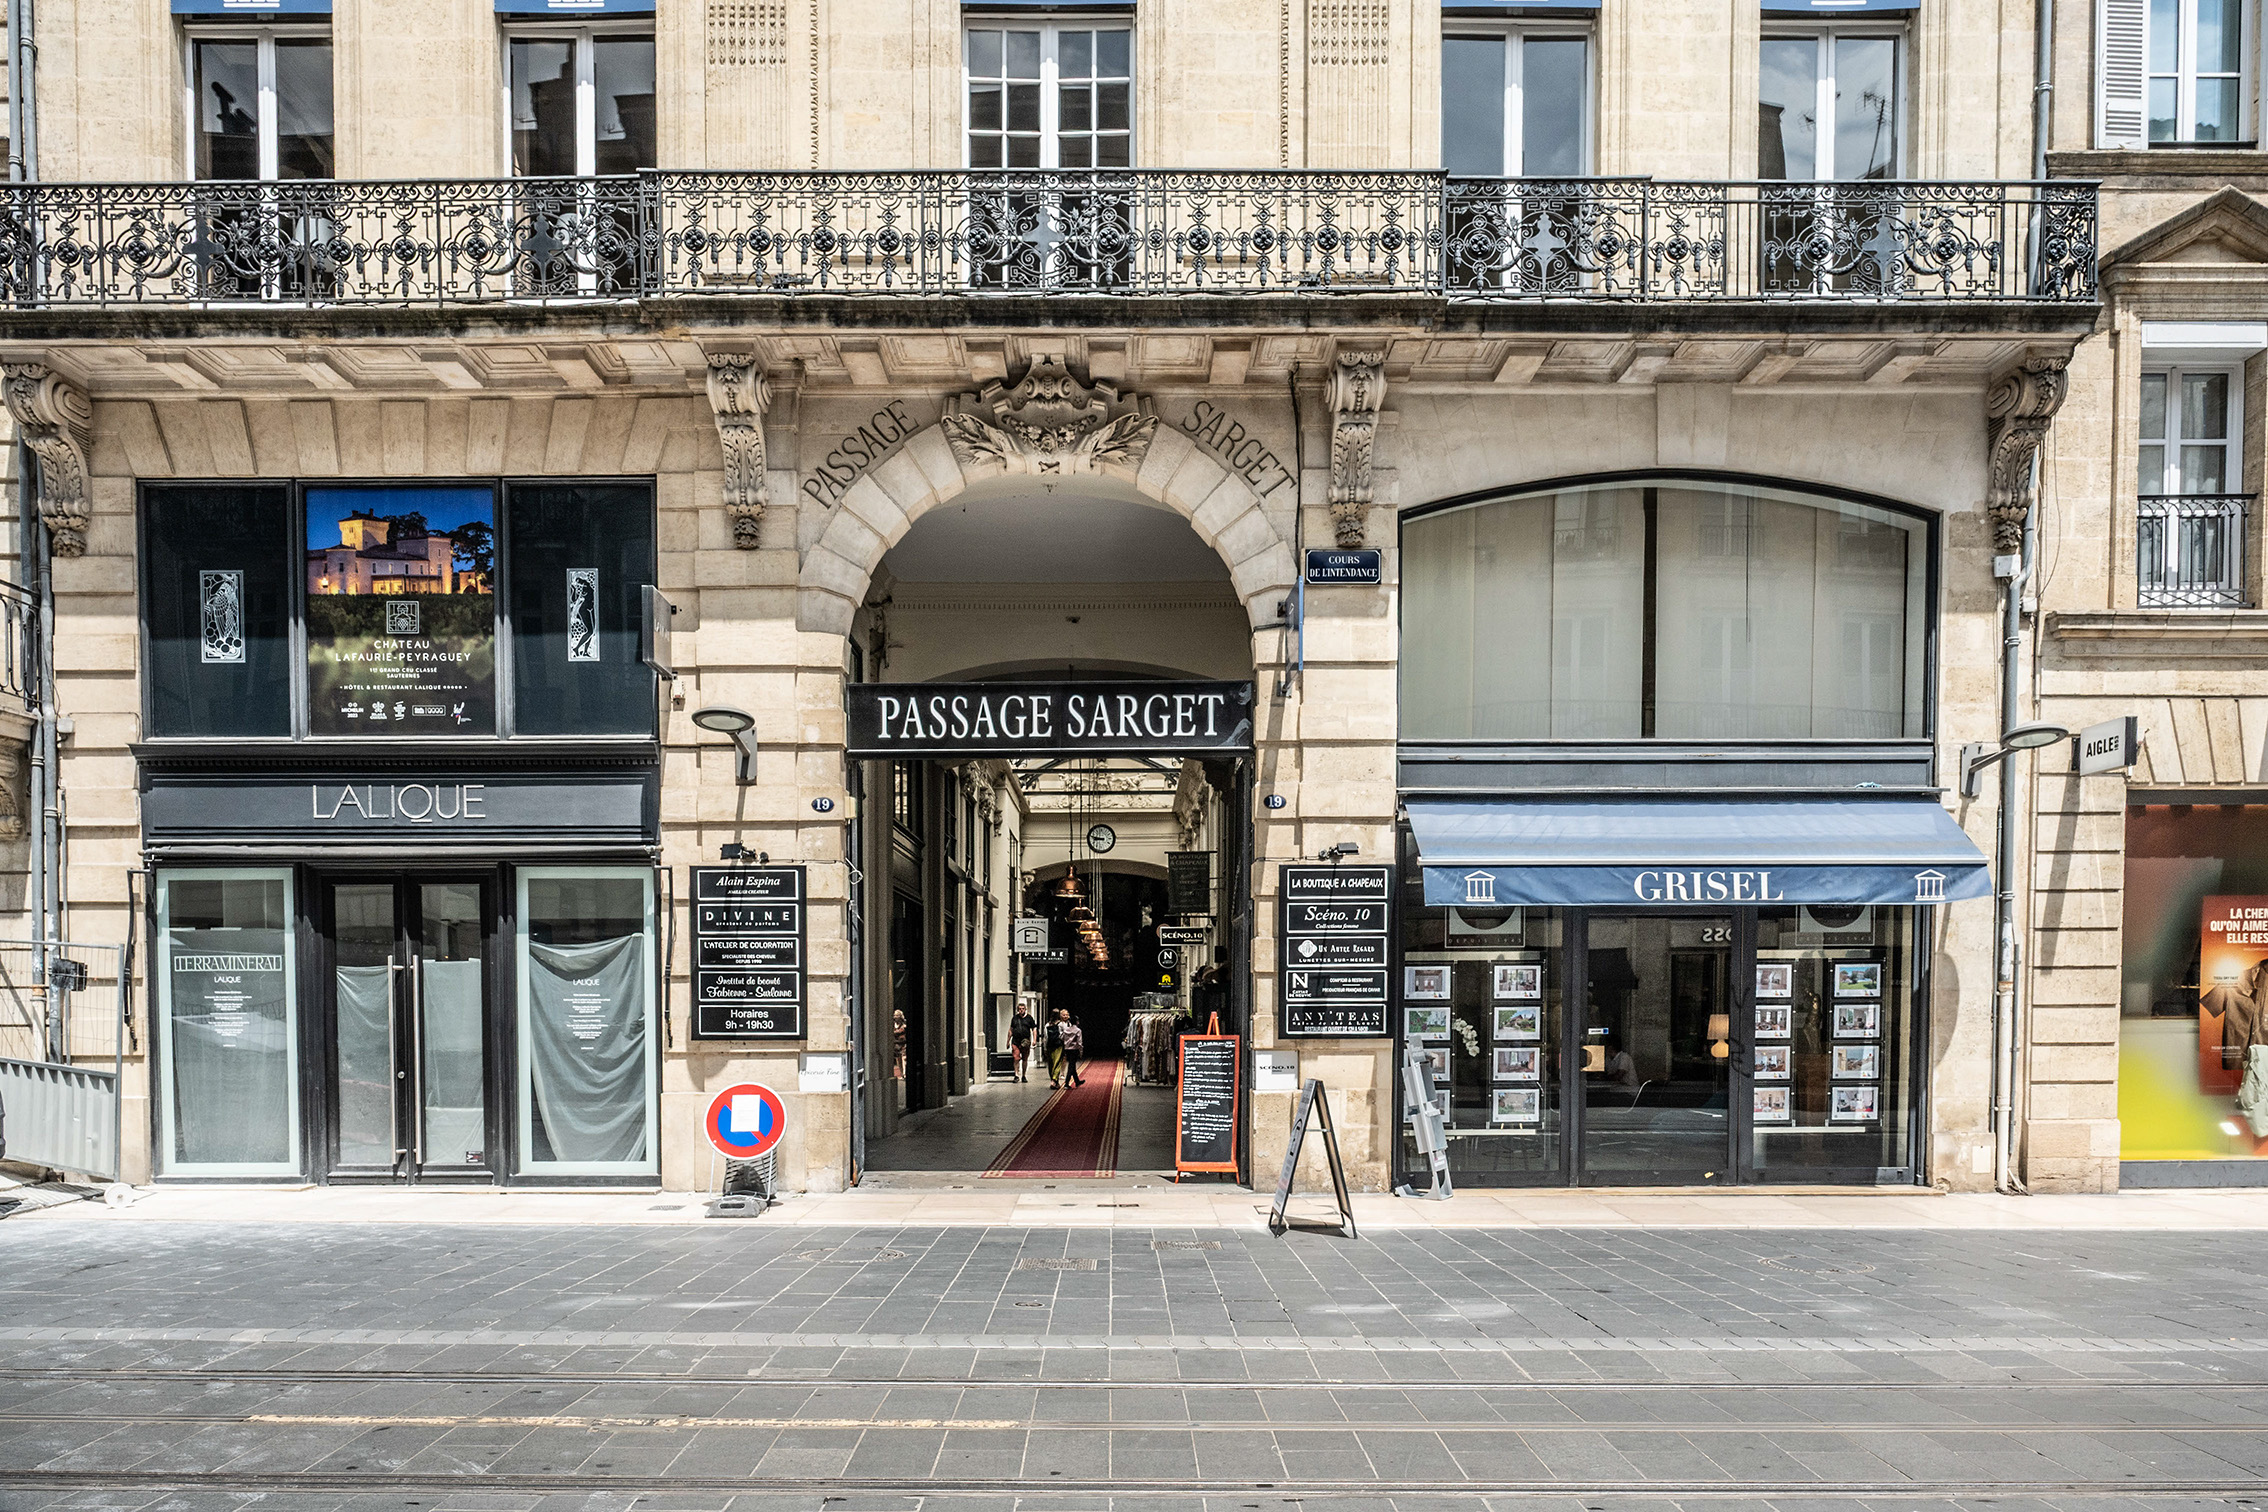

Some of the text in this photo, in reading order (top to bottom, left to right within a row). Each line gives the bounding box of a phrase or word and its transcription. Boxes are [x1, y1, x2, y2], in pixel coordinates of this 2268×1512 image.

[801, 399, 1297, 510] PASSAGE SARGET
[1328, 555, 1360, 564] COURS
[1309, 568, 1378, 577] DE L'INTENDANCE
[373, 639, 430, 649] CHÂTEAU
[335, 652, 471, 662] LAFAURIE-PEYRAGUEY
[877, 694, 1225, 739] PASSAGE SARGET
[2086, 736, 2114, 758] AIGLE
[312, 784, 487, 823] LALIQUE
[815, 798, 831, 810] 19
[1269, 796, 1283, 807] 19
[716, 876, 781, 888] Alain Espina
[1291, 879, 1301, 888] LA
[1302, 878, 1340, 890] BOUTIQUE
[1347, 878, 1384, 888] CHAPEAUX
[1633, 871, 1784, 901] GRISEL
[705, 911, 790, 921] DIVINE
[1304, 906, 1371, 921] Scéno. 10
[2230, 908, 2243, 919] LA
[2210, 920, 2240, 932] QU'ON
[2226, 933, 2249, 944] ELLE
[1163, 951, 1173, 960] N
[715, 975, 745, 985] Institut
[746, 976, 756, 985] de
[1292, 973, 1309, 988] N
[706, 986, 747, 998] Fabienne
[730, 1009, 769, 1018] Horaires
[725, 1020, 737, 1029] 9h
[745, 1020, 774, 1030] 19h30
